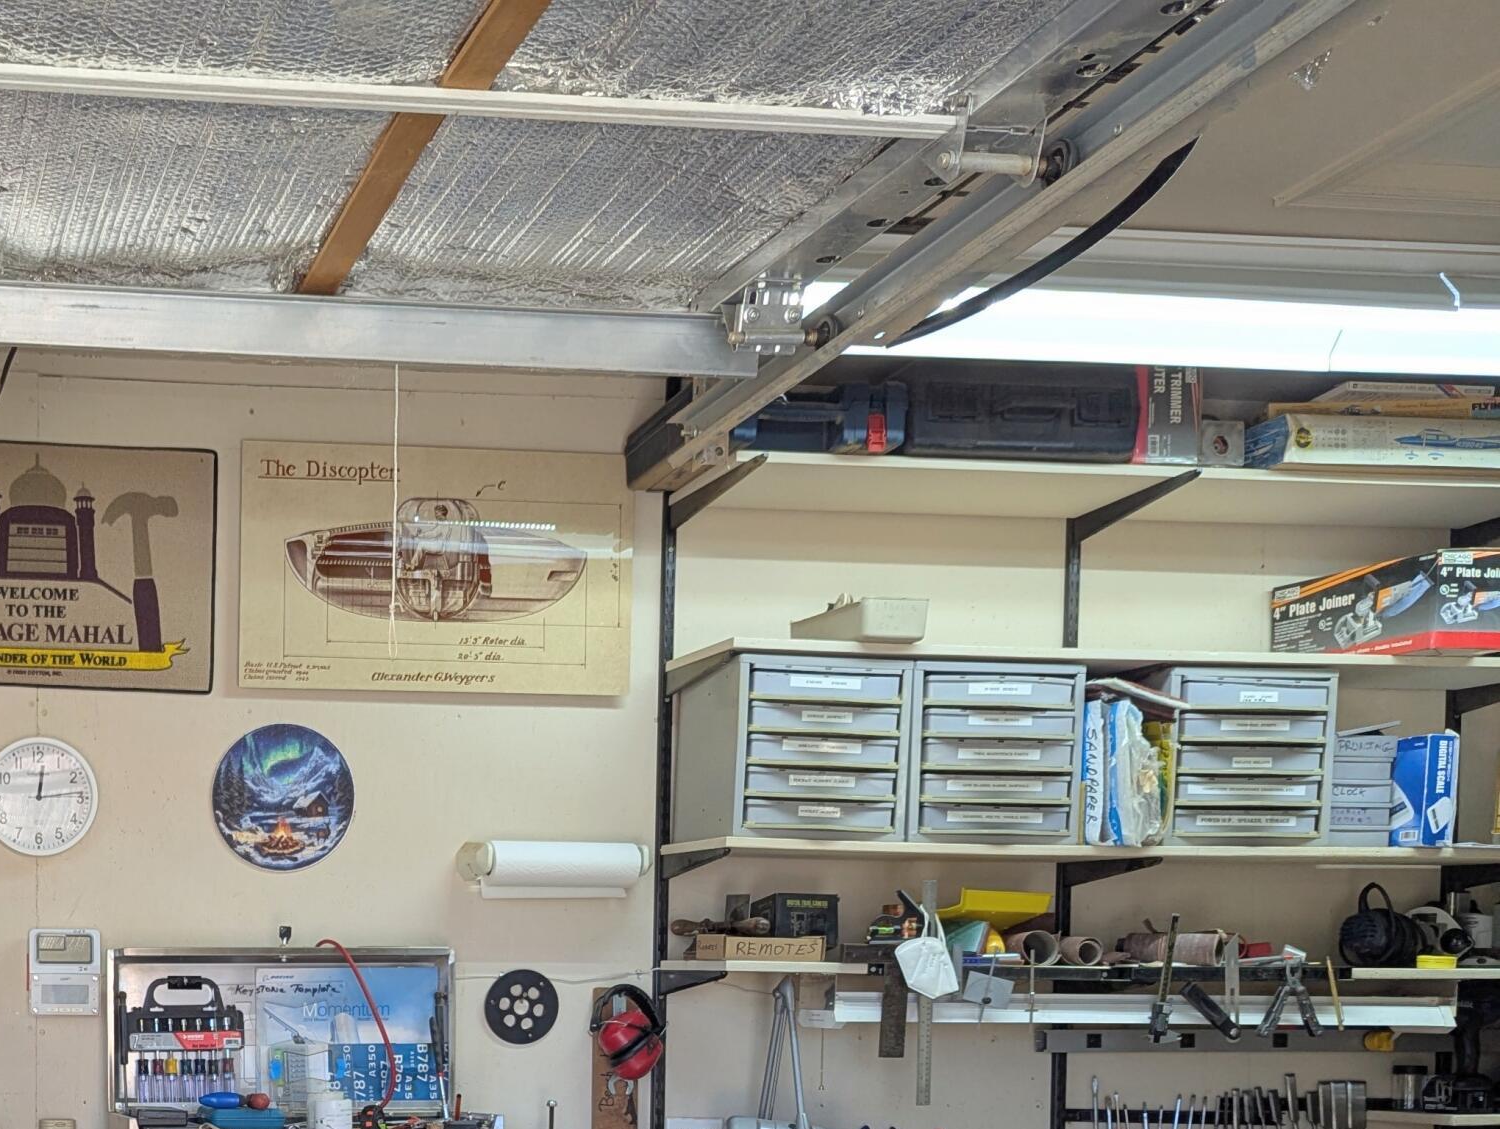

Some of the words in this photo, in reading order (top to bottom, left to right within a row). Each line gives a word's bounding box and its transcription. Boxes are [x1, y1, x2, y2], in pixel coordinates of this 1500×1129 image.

[1169, 371, 1182, 425] TRIMMER
[260, 459, 297, 477] The
[1456, 567, 1482, 578] Plate
[5, 604, 29, 618] TO
[33, 604, 67, 619] THE
[1289, 600, 1316, 618] Plate
[1319, 593, 1356, 613] Joiner
[46, 624, 133, 645] MAHAL
[31, 653, 47, 664] OF
[51, 654, 75, 665] THE
[79, 653, 128, 667] WORLD
[371, 671, 433, 683] Alexander
[32, 750, 44, 764] 12
[1437, 740, 1448, 770] DIGITAL
[15, 756, 23, 769] 11
[0, 772, 11, 785] 10
[69, 771, 77, 783] 2
[1435, 771, 1446, 794] SCALE
[76, 791, 84, 804] 3
[0, 812, 7, 824] 8
[70, 812, 77, 824] 4
[15, 826, 23, 839] 7
[55, 827, 63, 840] 5
[35, 832, 43, 845] 6
[735, 941, 818, 956] REMOTES
[368, 1044, 376, 1077] A350
[417, 1043, 429, 1082] B787
